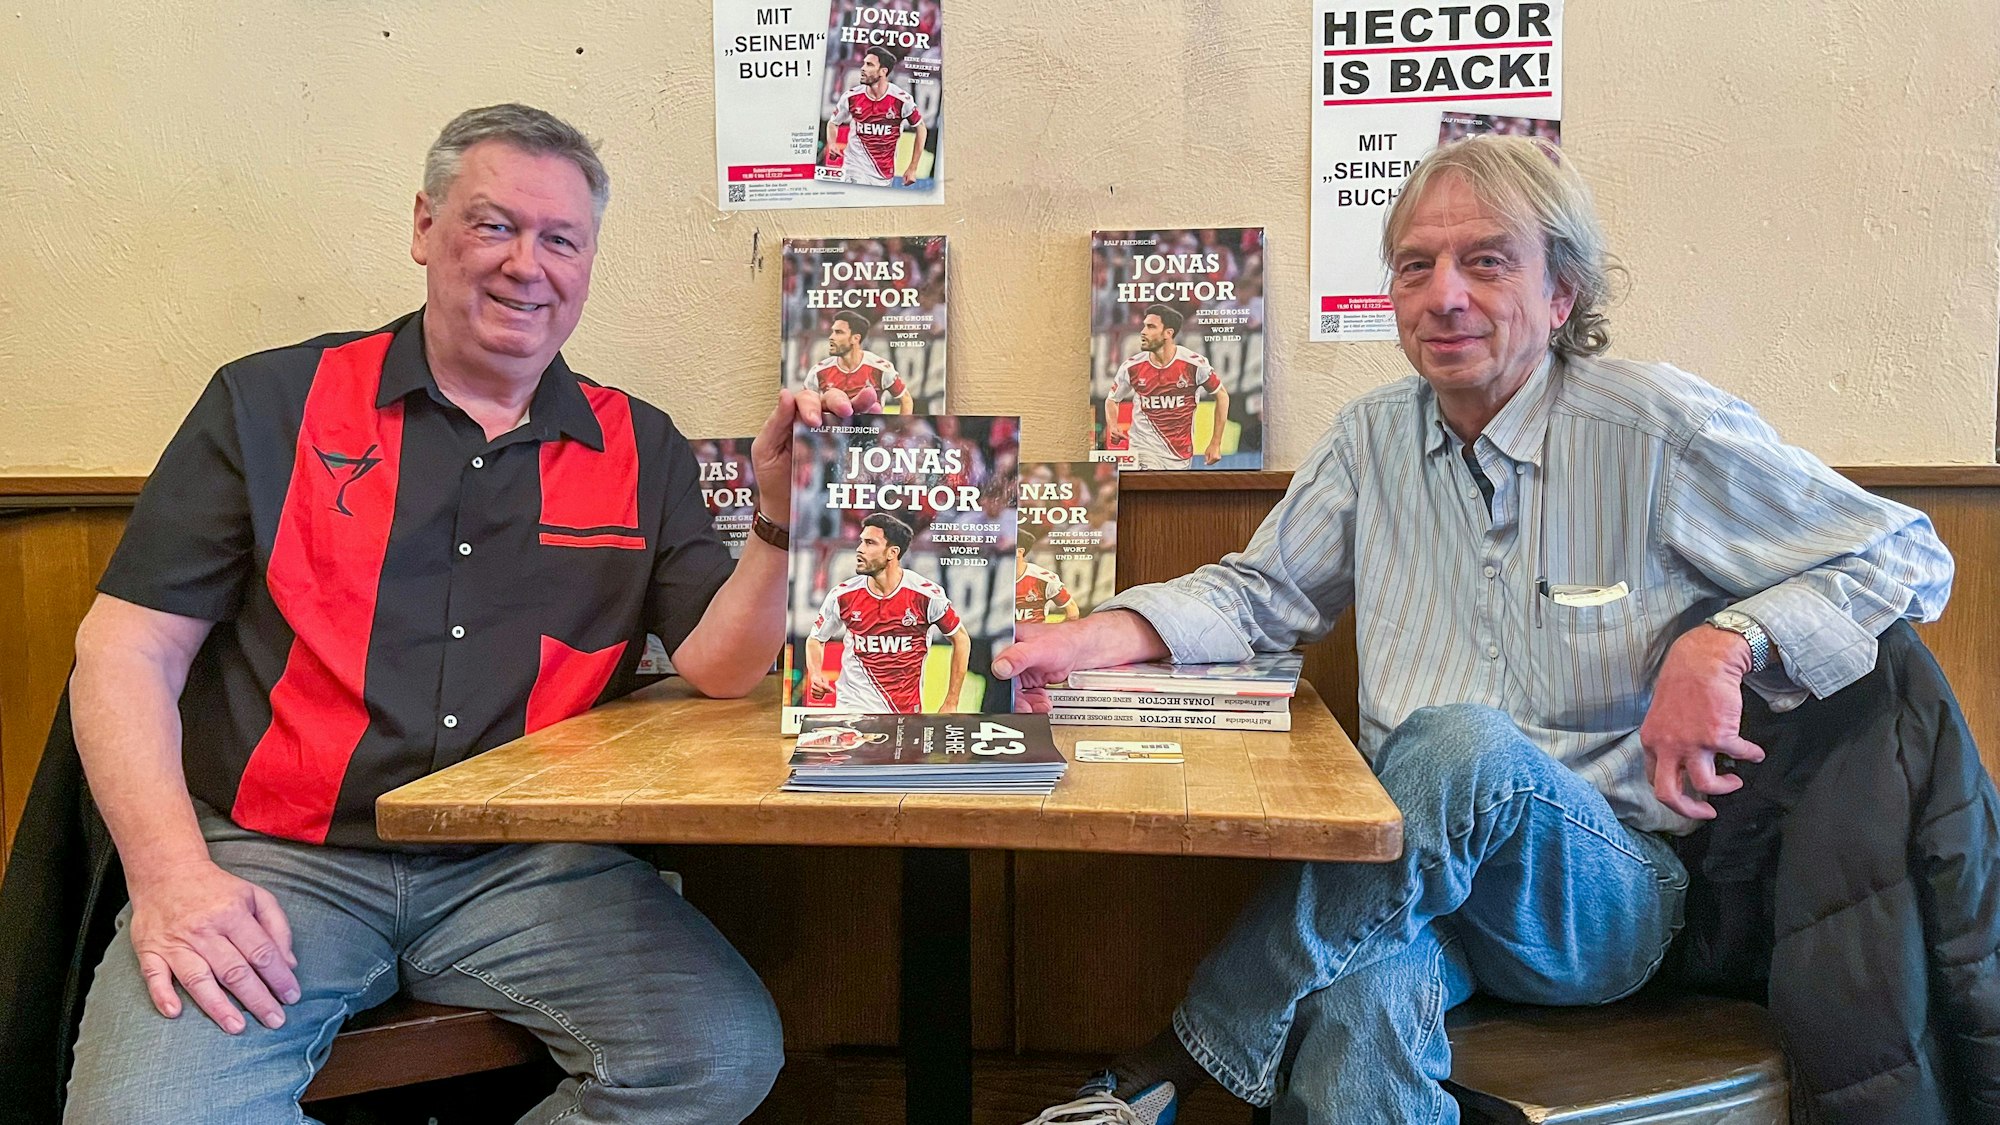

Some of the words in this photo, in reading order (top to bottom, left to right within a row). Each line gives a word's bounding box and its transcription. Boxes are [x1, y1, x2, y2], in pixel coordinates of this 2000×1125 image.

[757, 8, 792, 26] MIT
[854, 6, 920, 27] JONAS
[1324, 3, 1552, 46] HECTOR
[724, 33, 825, 56] „SEINEM“
[840, 27, 930, 50] HECTOR
[740, 61, 798, 79] BUCH
[807, 60, 811, 76] !
[1323, 60, 1370, 96] IS
[1390, 53, 1550, 93] BACK!
[856, 123, 892, 136] REWE
[1359, 134, 1397, 151] MIT
[821, 261, 904, 286] JONAS
[1132, 253, 1220, 280] JONAS
[806, 288, 920, 308] HECTOR
[1118, 282, 1236, 302] HECTOR
[1141, 395, 1185, 409] REWE
[832, 426, 880, 434] FRIEDRICHS
[847, 447, 962, 480] JONAS
[826, 482, 983, 512] HECTOR
[1021, 483, 1073, 501] NAS
[1017, 506, 1088, 525] CTOR
[932, 535, 983, 543] KARRIERE
[949, 546, 979, 554] WORT
[940, 558, 961, 566] UND
[854, 634, 912, 654] REWE
[1138, 697, 1180, 705] HECTOR
[1183, 697, 1215, 705] JONAS
[1139, 715, 1181, 723] HECTOR
[1184, 716, 1216, 724] JONAS
[945, 724, 965, 754] JAHRE
[970, 721, 1026, 755] 43
